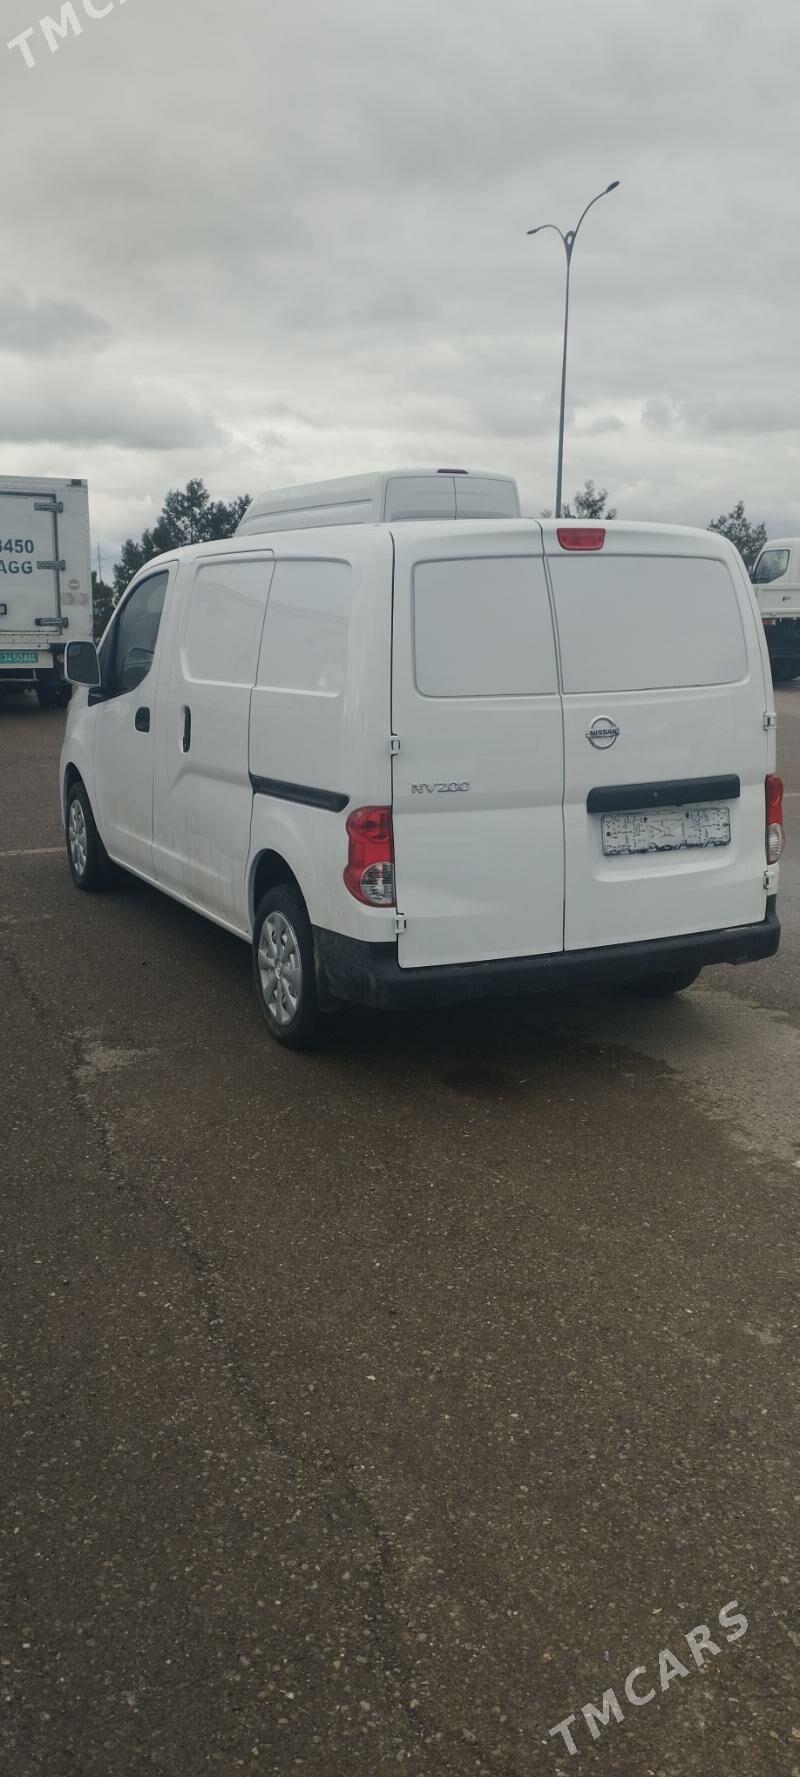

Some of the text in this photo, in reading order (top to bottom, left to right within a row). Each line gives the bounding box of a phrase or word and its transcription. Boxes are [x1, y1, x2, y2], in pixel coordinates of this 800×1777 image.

[0, 560, 33, 574] AGG
[590, 728, 618, 736] NISSAN
[411, 782, 470, 794] NV200
